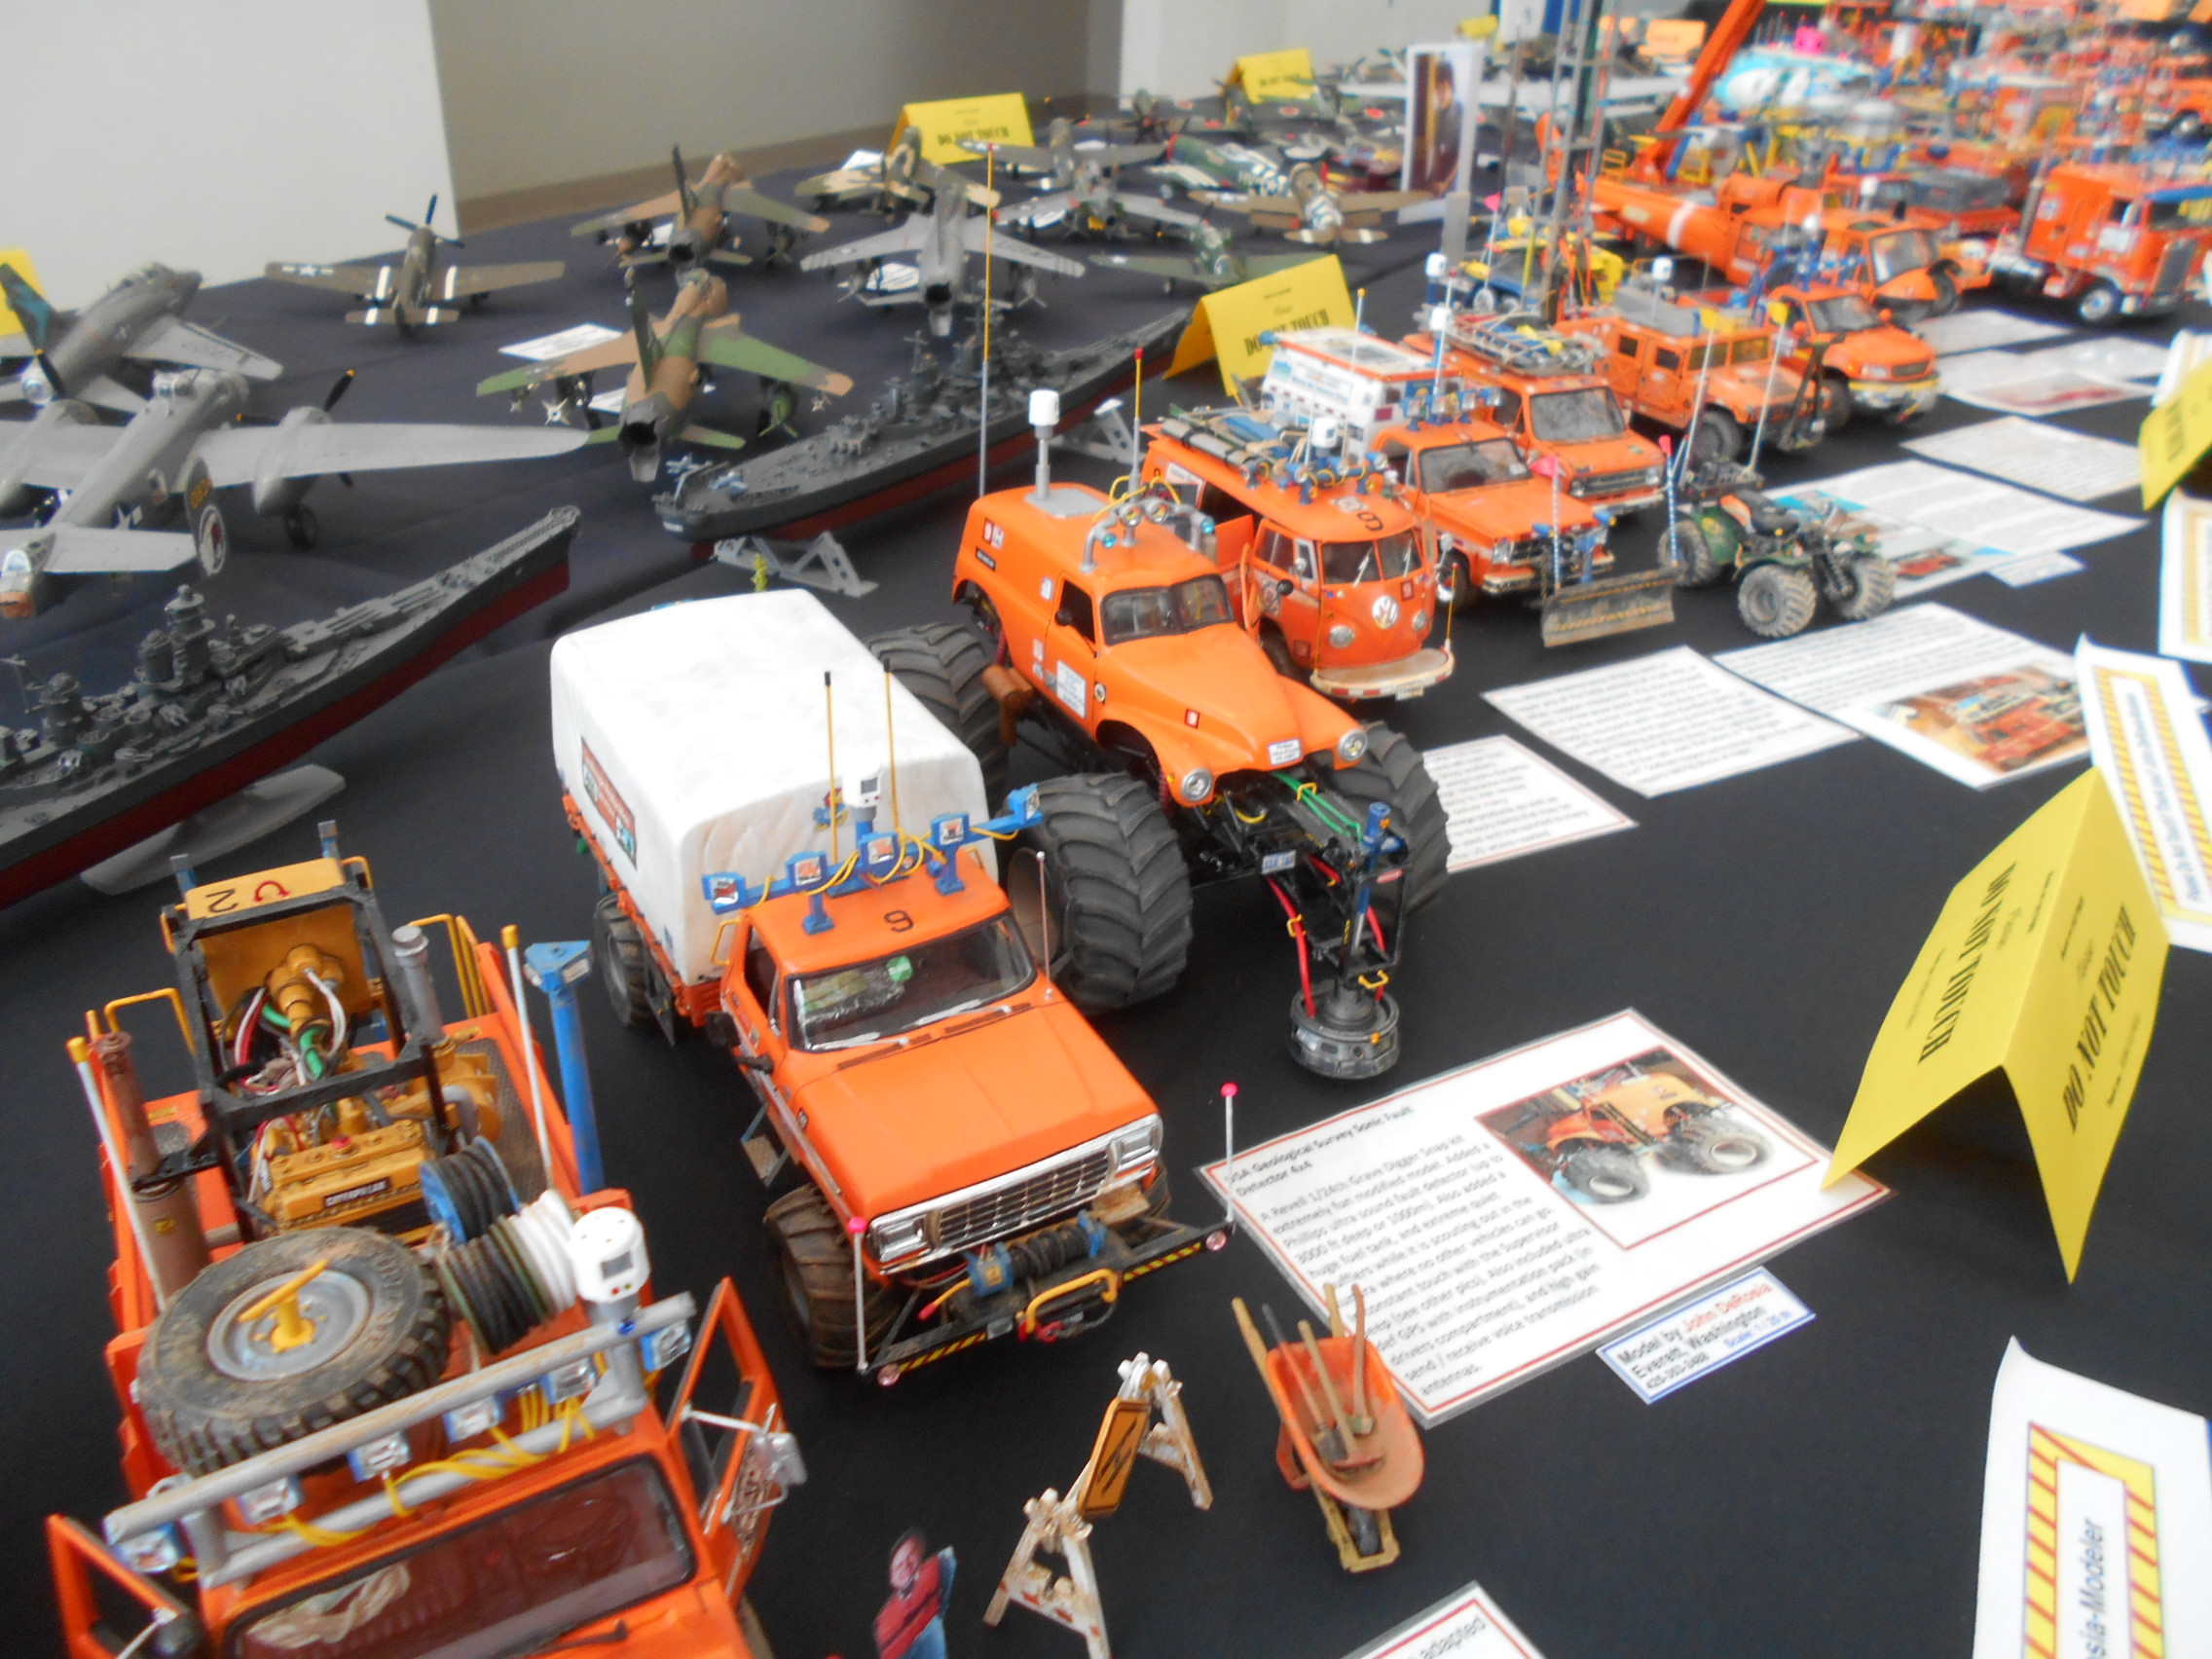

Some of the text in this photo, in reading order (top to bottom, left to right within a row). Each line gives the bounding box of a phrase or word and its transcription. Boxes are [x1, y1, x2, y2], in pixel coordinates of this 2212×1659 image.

[1980, 862, 2017, 907] DO
[1958, 899, 2003, 960] NOT
[1917, 951, 1982, 1065] TOUCH
[2063, 1063, 2084, 1135] DO
[2077, 993, 2107, 1083] NOT
[2097, 903, 2136, 1012] TOUCH
[1617, 1338, 1662, 1365] Model
[1661, 1328, 1683, 1343] by
[1686, 1307, 1766, 1349] Washington
